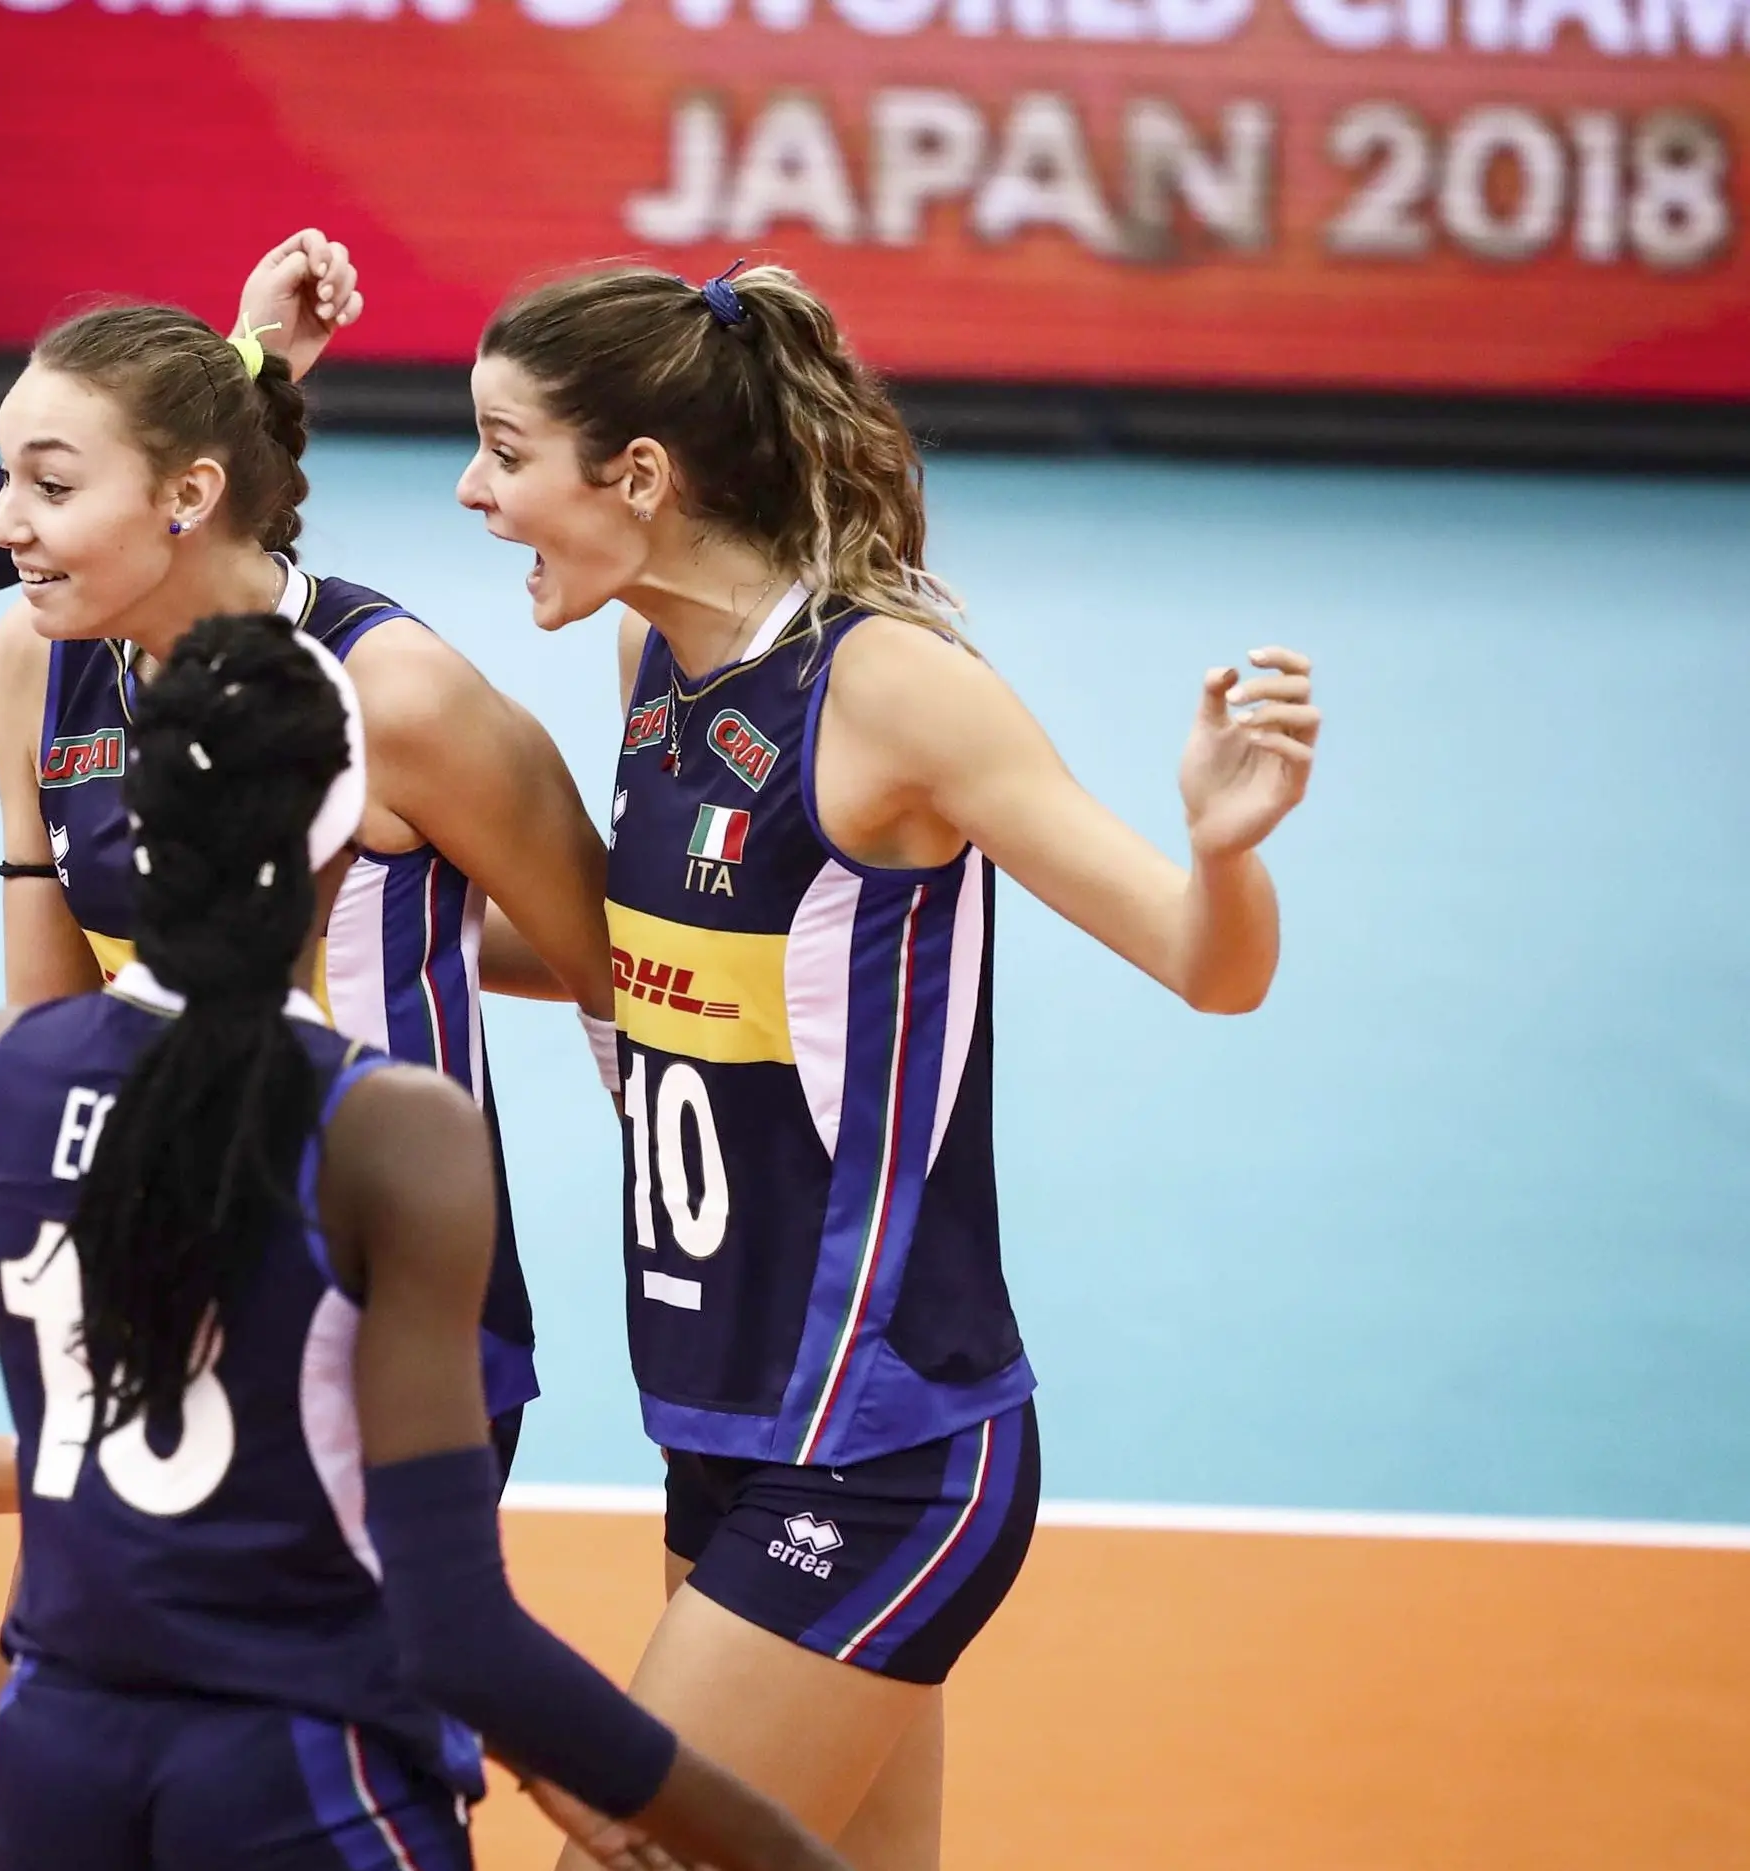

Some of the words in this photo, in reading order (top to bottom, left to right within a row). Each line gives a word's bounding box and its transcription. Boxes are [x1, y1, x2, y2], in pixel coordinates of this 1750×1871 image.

[624, 90, 1272, 262] JAPAN
[1323, 100, 1729, 268] 2018
[42, 737, 119, 780] CRAI
[714, 717, 773, 782] CRAI
[684, 858, 735, 898] ITA
[611, 945, 705, 1015] DHL
[623, 1051, 730, 1261] 10
